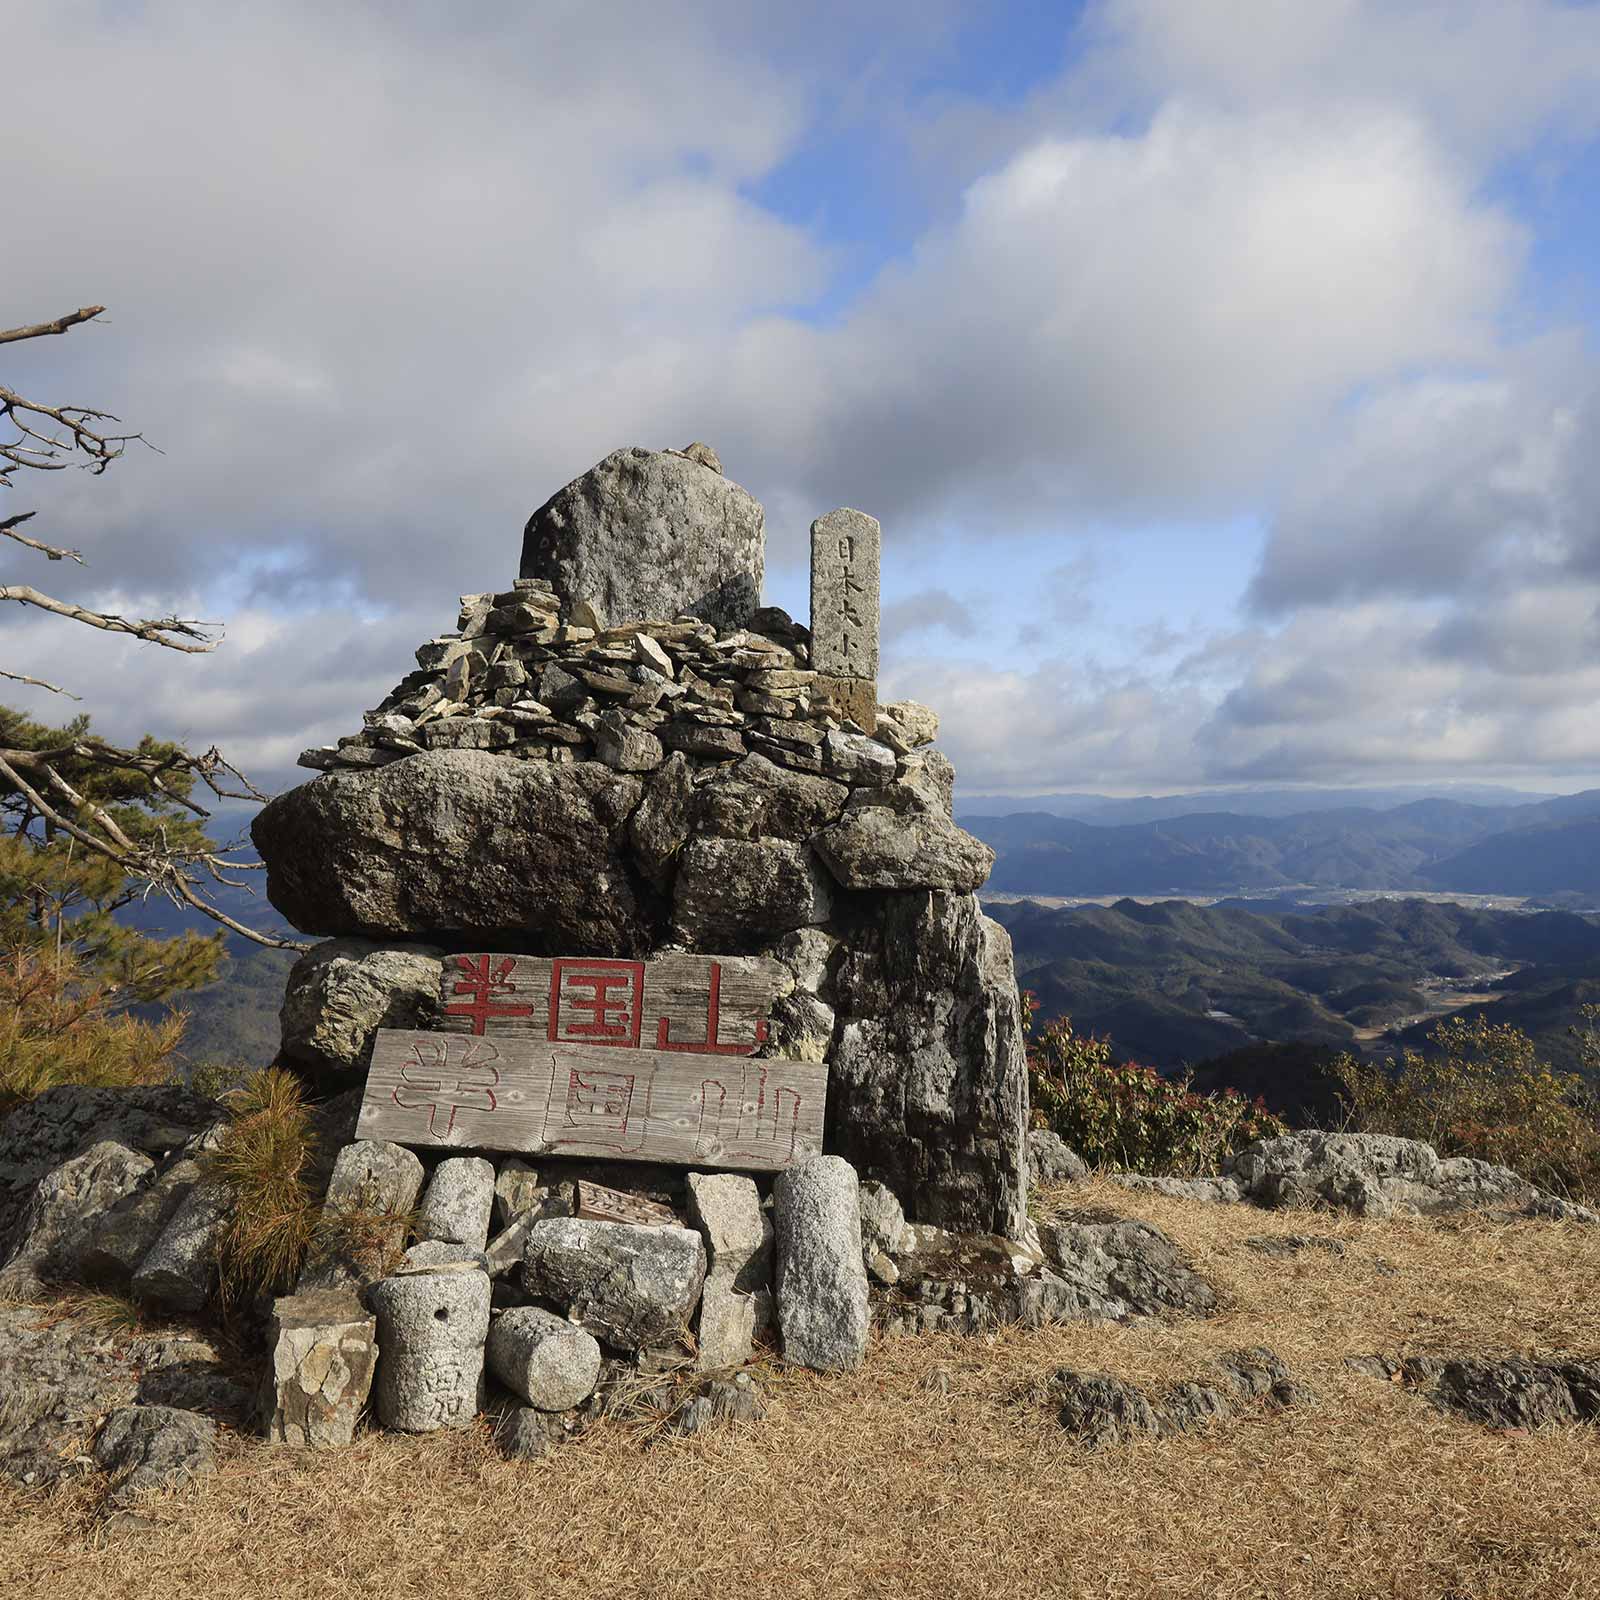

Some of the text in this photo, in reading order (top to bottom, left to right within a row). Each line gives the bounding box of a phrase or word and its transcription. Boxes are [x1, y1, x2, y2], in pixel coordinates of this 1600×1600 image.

[443, 954, 768, 1054] 半国山
[392, 1037, 801, 1163] 半国山
